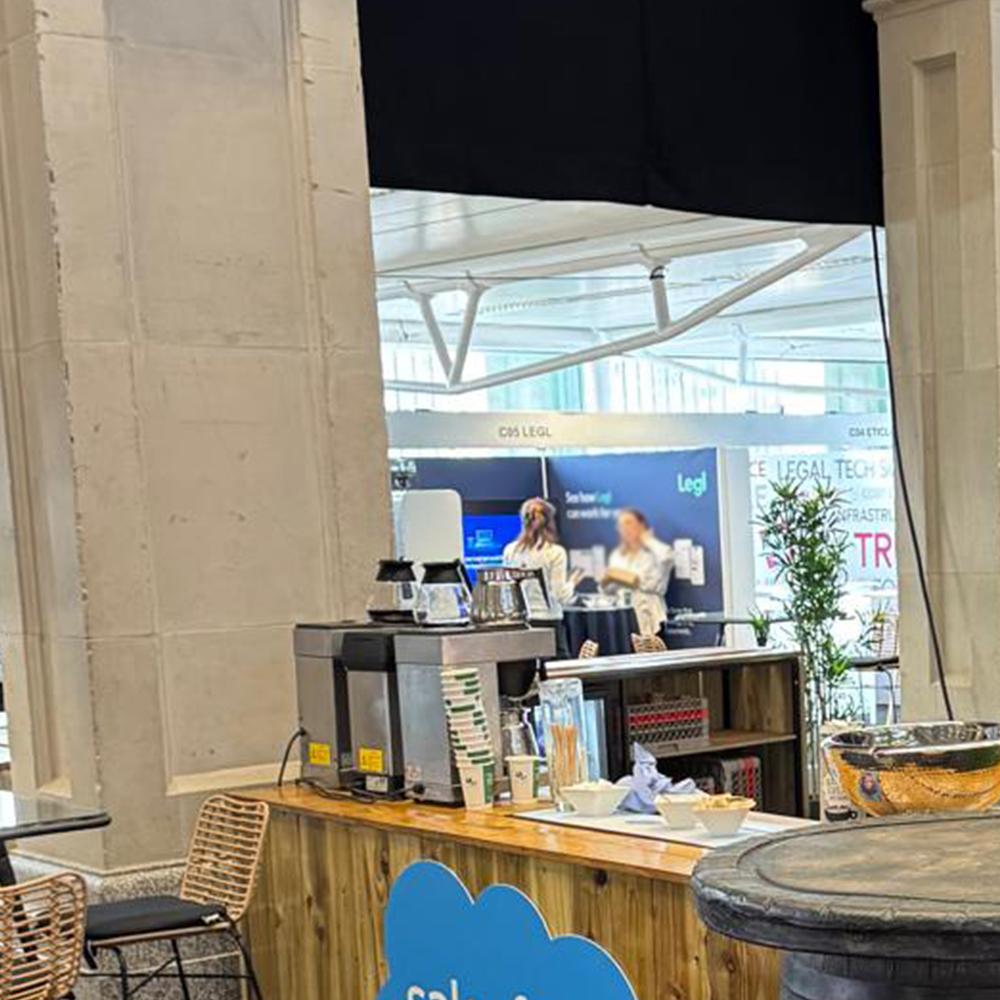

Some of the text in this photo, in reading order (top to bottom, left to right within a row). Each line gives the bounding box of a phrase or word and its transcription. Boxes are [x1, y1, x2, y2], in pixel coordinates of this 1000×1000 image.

[522, 427, 552, 437] LEGL
[777, 459, 831, 480] LEGAL
[677, 470, 707, 496] Legl
[854, 533, 892, 568] TR
